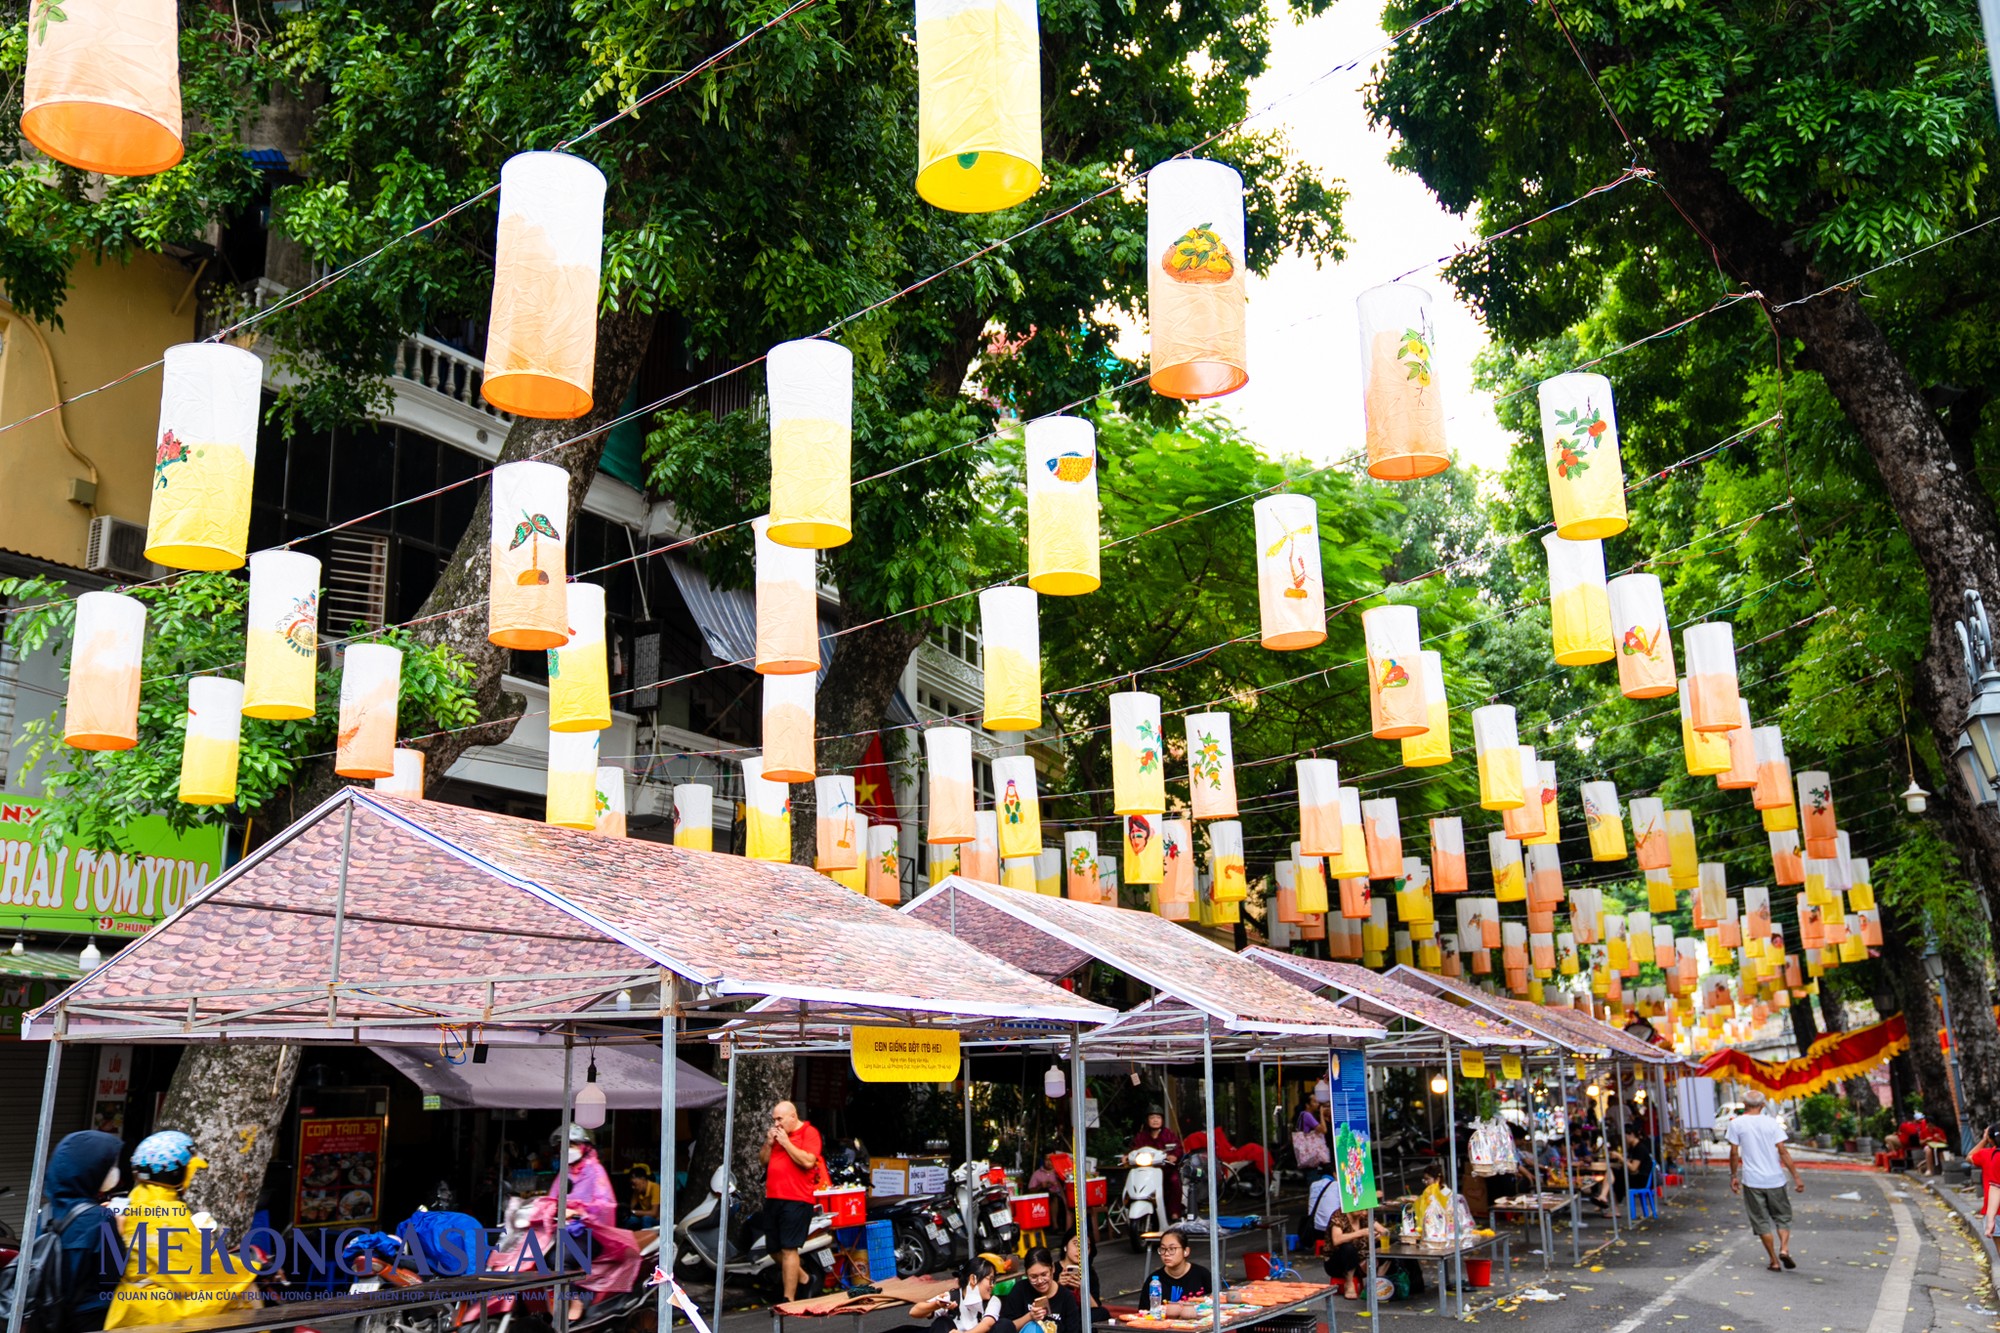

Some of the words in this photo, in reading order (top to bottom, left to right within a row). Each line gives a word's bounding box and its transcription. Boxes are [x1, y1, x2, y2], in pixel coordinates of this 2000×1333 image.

[73, 847, 209, 919] TOMYUM
[98, 915, 114, 931] 9
[914, 1182, 924, 1194] 15K
